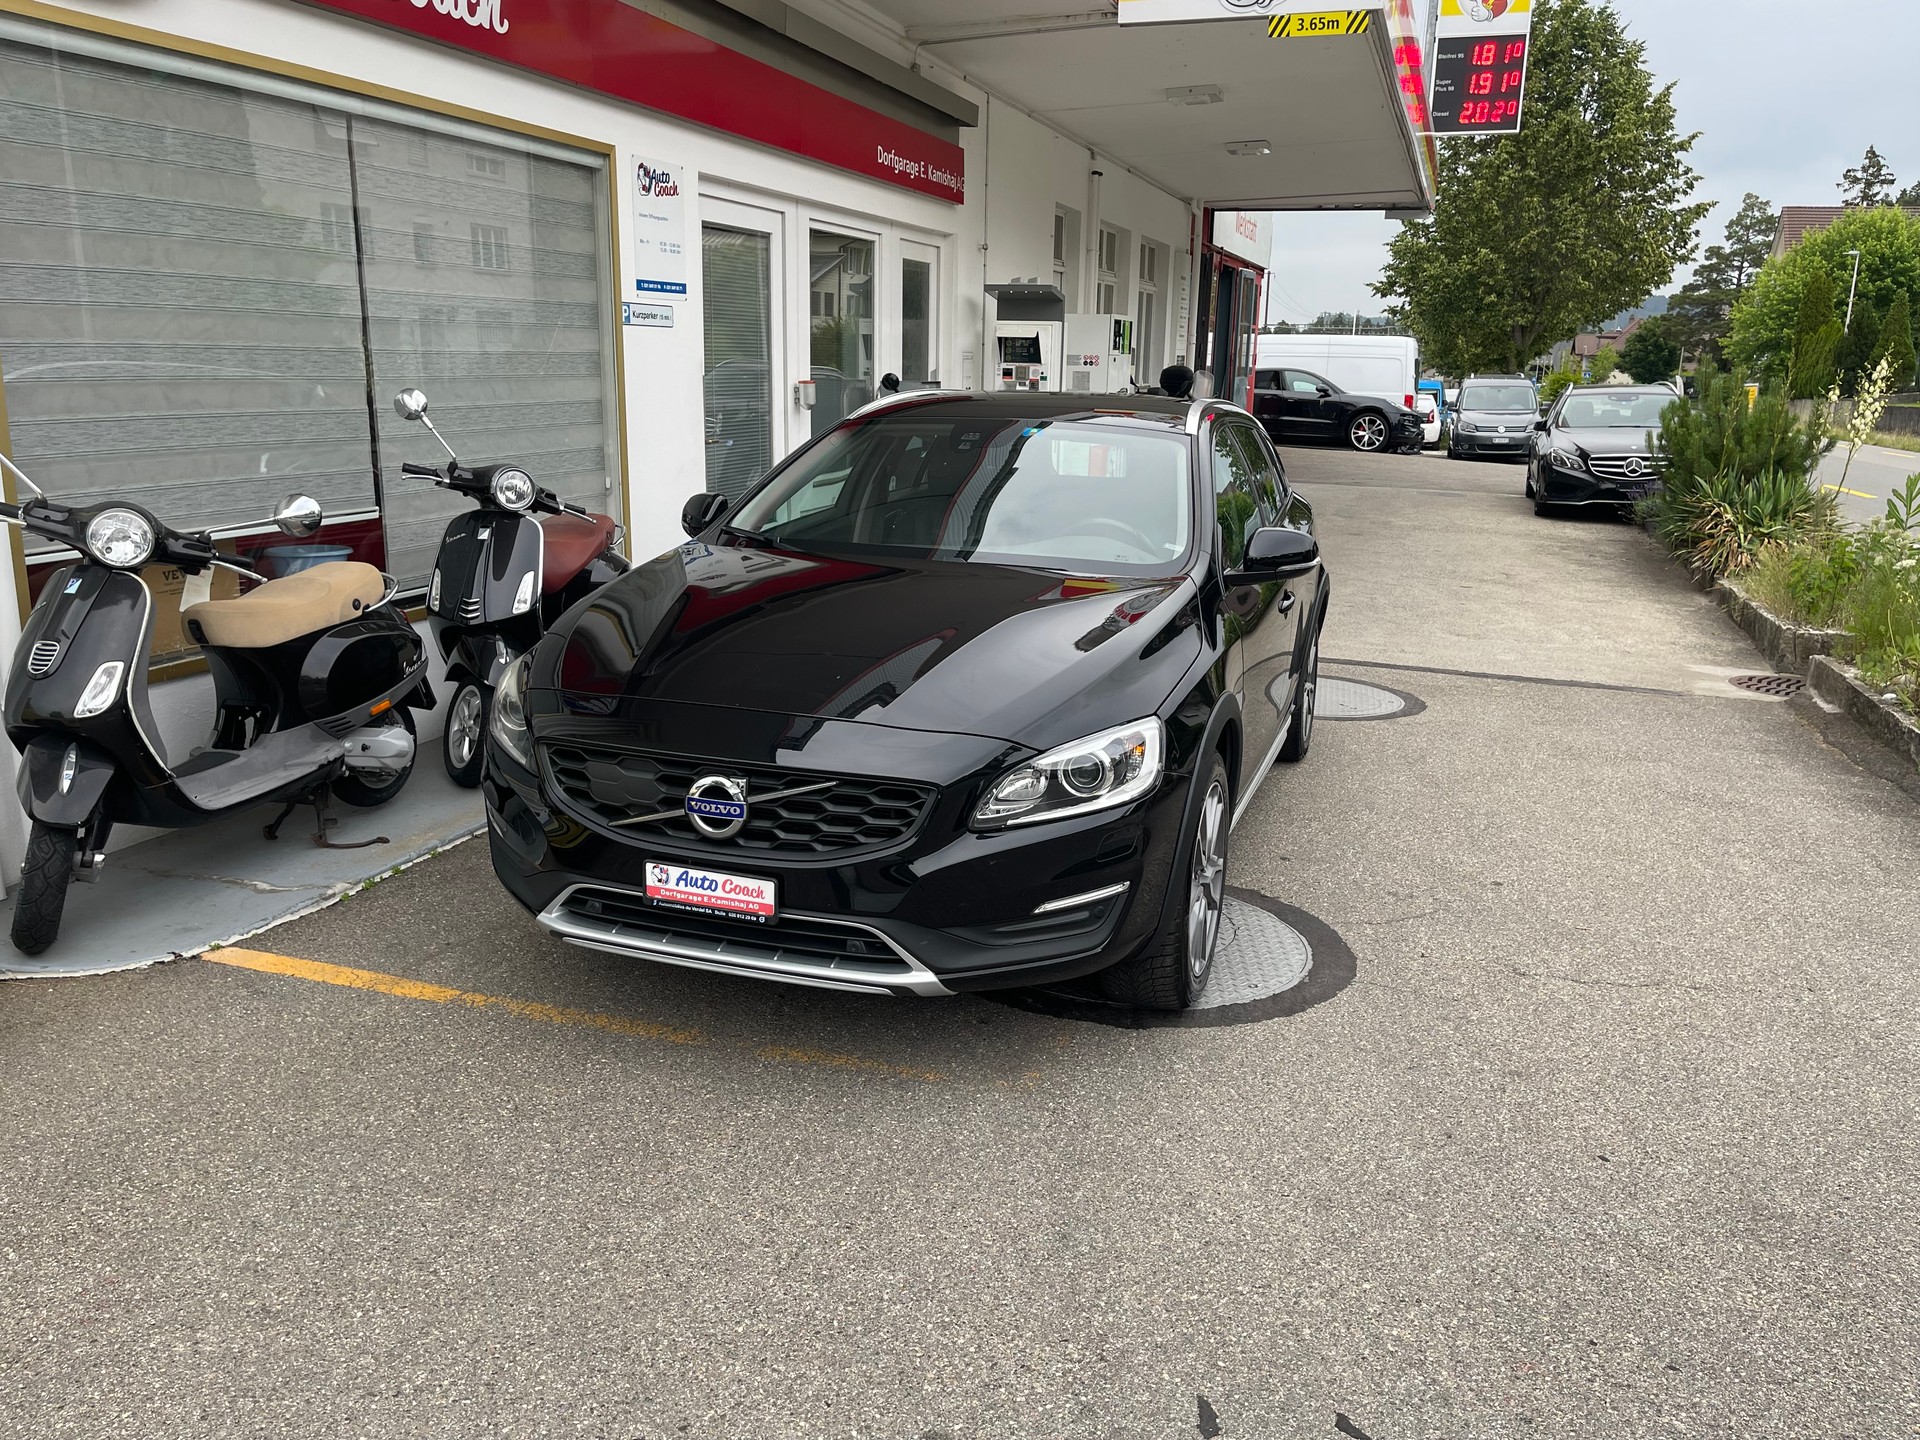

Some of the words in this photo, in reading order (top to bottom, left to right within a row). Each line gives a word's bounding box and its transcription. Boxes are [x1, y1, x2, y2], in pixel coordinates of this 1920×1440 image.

[1296, 16, 1340, 32] 3.65m
[651, 168, 670, 184] Auto
[877, 145, 919, 179] Dorfgarage
[920, 161, 927, 178] E.
[928, 163, 957, 193] Kamishaj
[653, 180, 679, 197] Coach
[632, 311, 658, 321] Kurzparker
[689, 800, 741, 815] VOLVO
[675, 870, 719, 892] Auto
[721, 878, 765, 900] Coach
[660, 889, 702, 902] Dorfgarage
